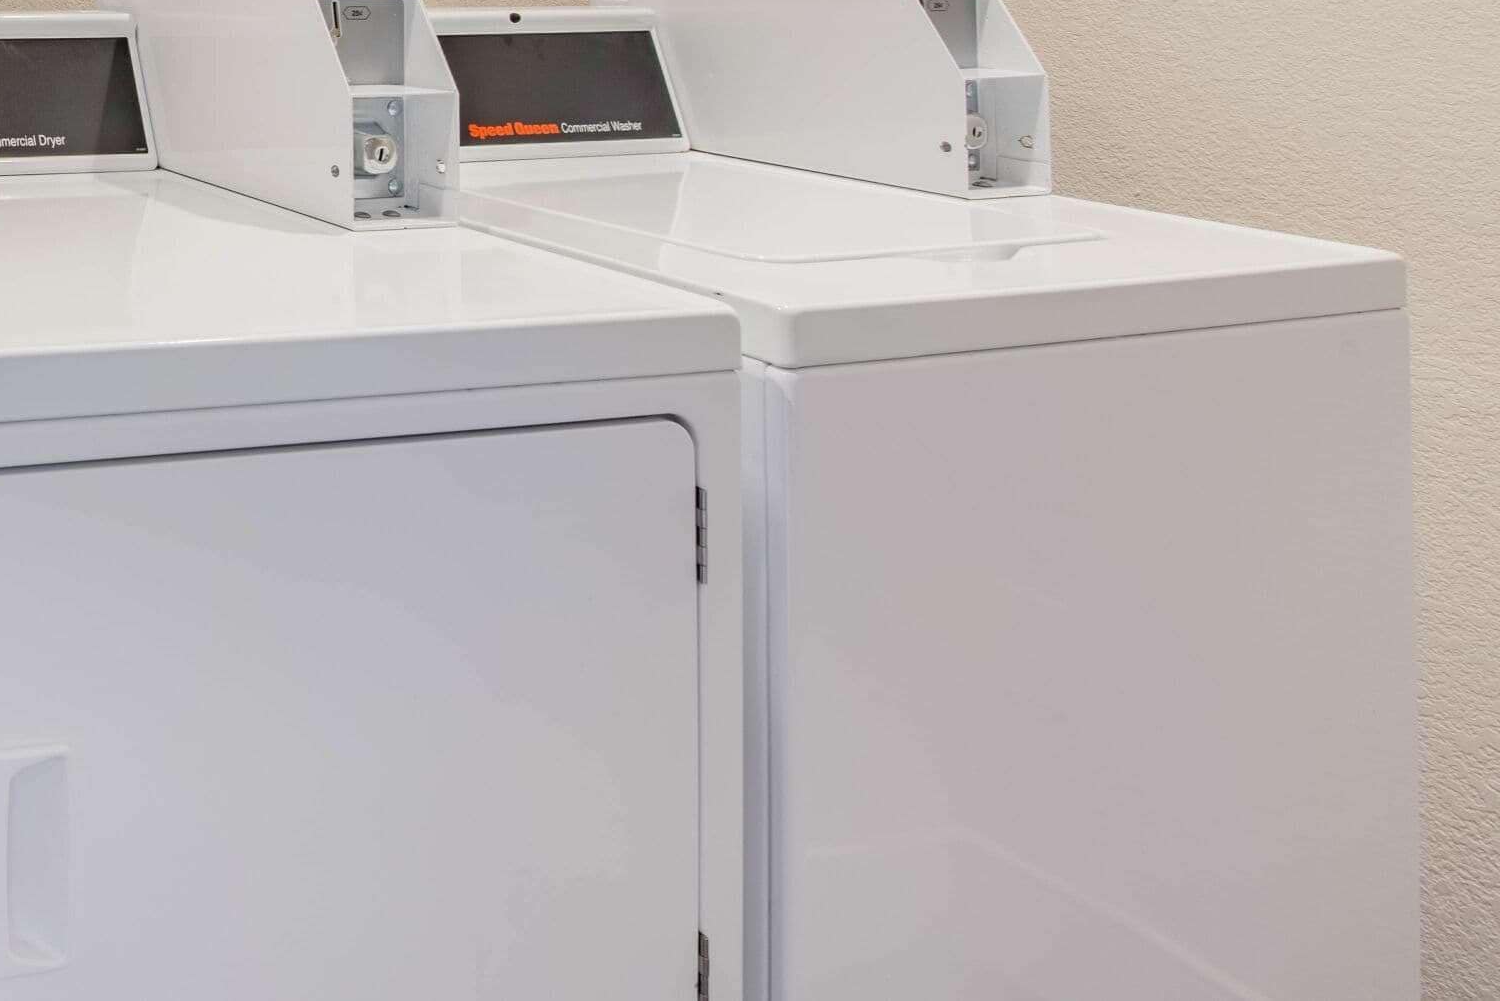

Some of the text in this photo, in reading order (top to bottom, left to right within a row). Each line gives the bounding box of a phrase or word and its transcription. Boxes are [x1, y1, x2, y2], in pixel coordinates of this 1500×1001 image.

[468, 120, 642, 139] Speed Queen Commercial Washer
[38, 134, 66, 149] Dryer
